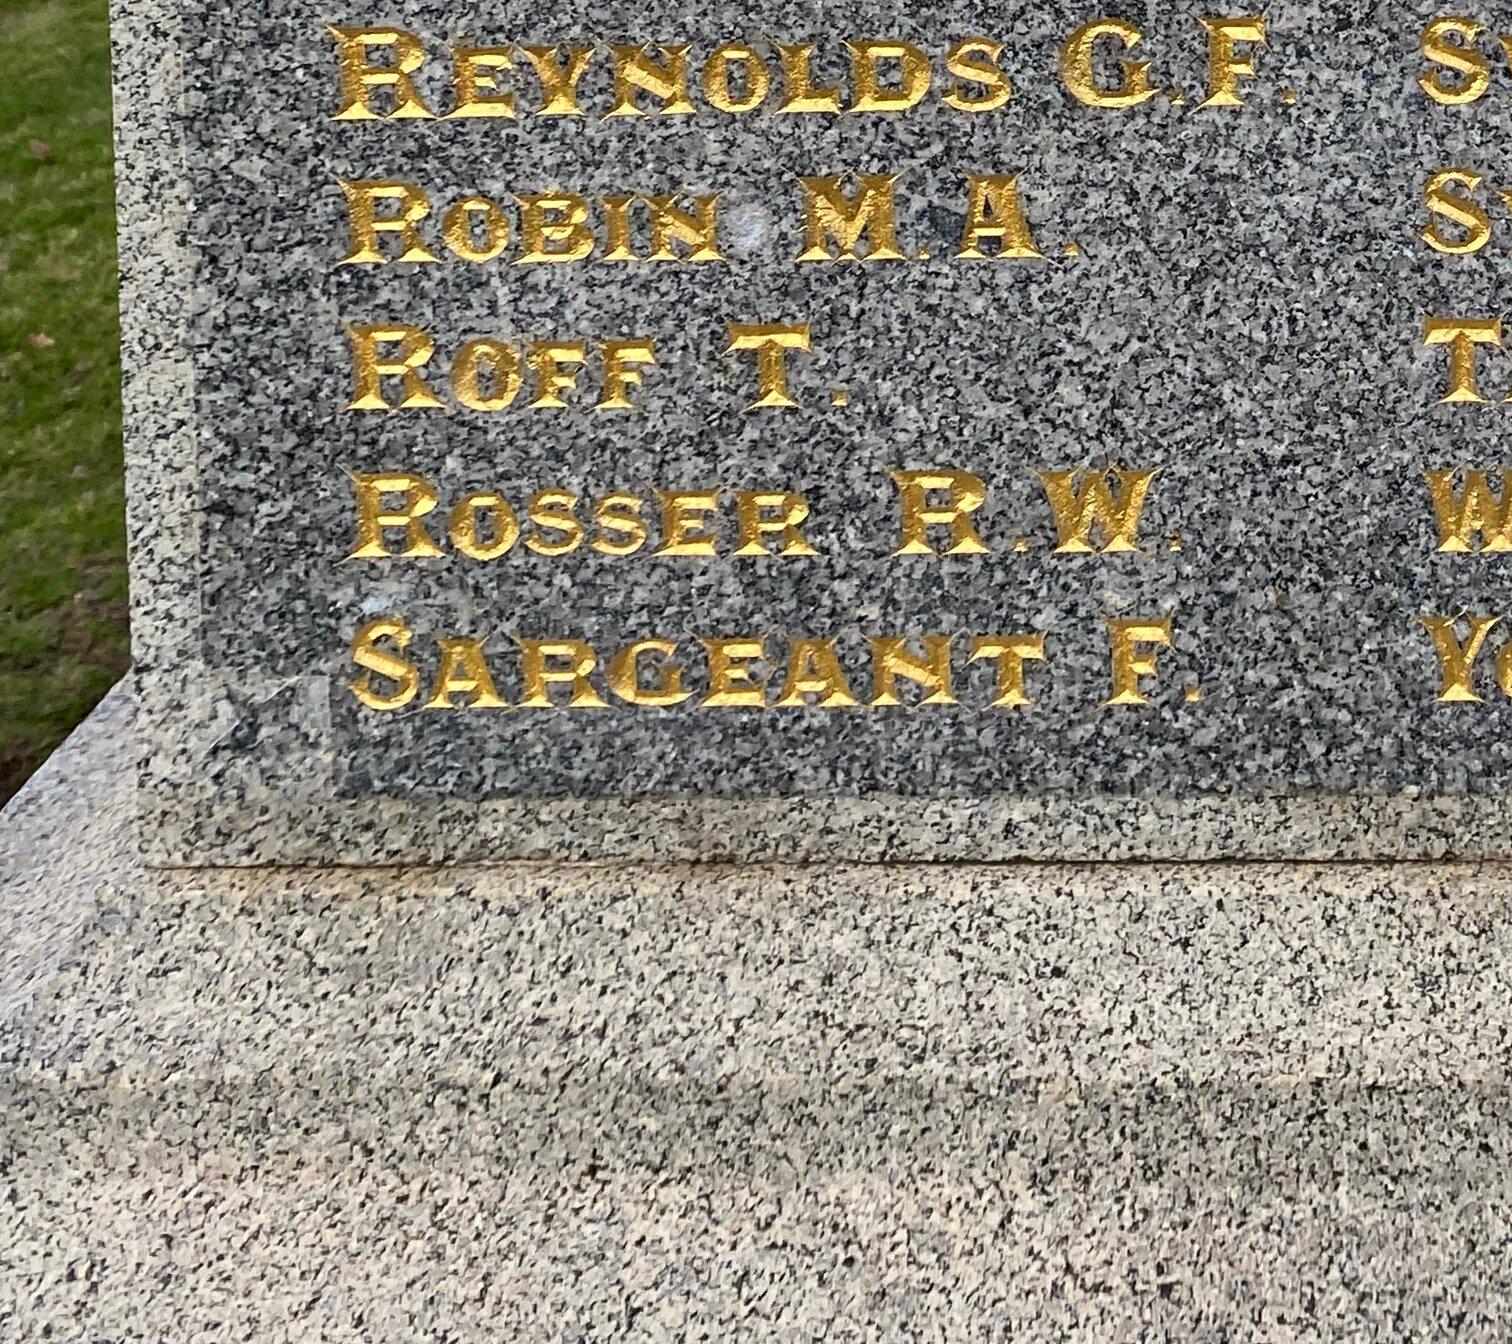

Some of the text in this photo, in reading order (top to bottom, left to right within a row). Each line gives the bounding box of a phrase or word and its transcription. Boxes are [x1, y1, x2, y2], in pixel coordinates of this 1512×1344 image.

[329, 24, 1011, 119] REYNOLDS
[334, 177, 726, 262] ROBIN
[344, 322, 658, 412] ROFF
[348, 469, 820, 557] ROSSER
[349, 617, 1045, 709] SARGEANT
